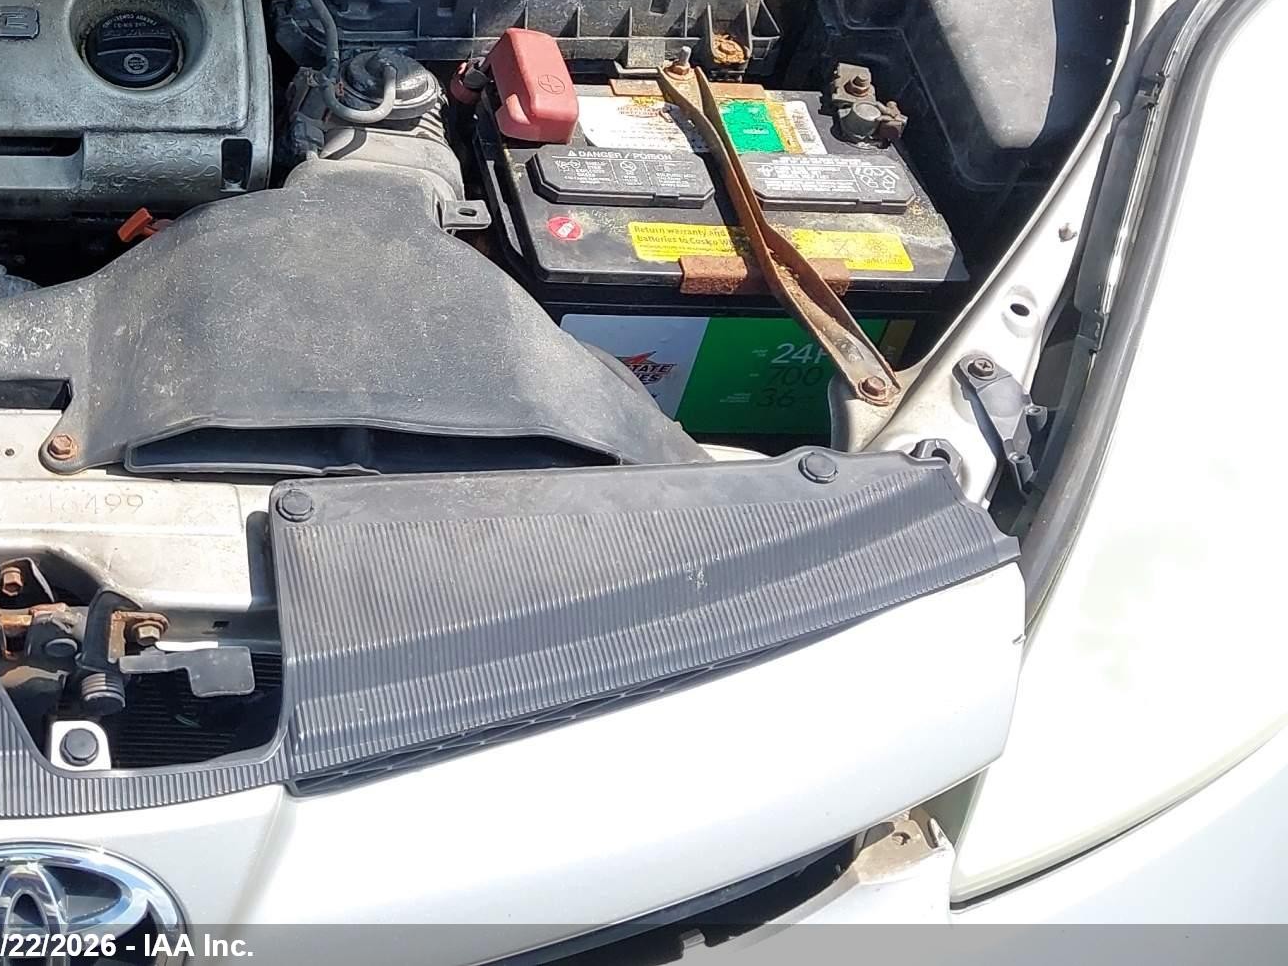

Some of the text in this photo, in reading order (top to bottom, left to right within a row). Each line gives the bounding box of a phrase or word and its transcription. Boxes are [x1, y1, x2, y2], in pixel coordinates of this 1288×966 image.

[578, 150, 622, 159] DANGER
[633, 152, 673, 161] POISON
[634, 225, 727, 237] Return warranty and
[766, 365, 825, 387] 700
